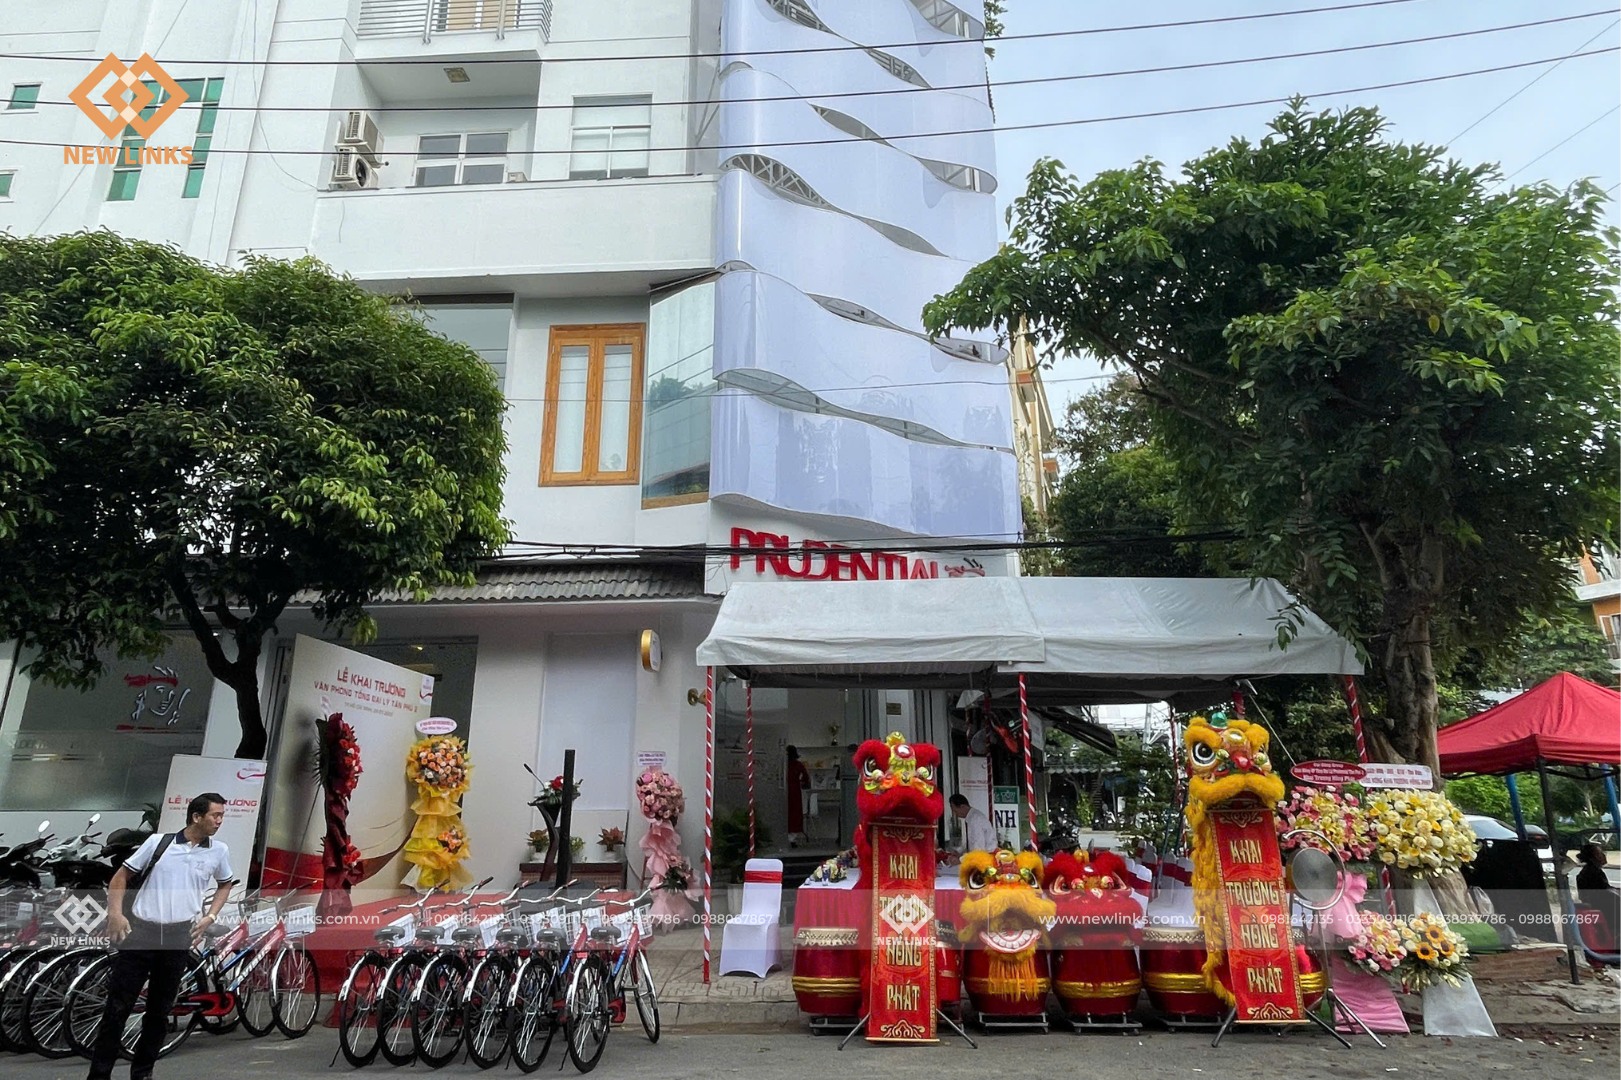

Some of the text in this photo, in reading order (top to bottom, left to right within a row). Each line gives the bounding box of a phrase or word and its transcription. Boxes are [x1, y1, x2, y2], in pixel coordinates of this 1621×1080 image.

[730, 527, 938, 581] PRUDENTIAL
[350, 673, 372, 689] KHAI
[224, 798, 257, 807] RƯƠNG
[1229, 839, 1263, 864] KHAI
[889, 854, 918, 880] KHAI
[1240, 913, 1279, 949] HỒNG
[1247, 962, 1283, 994] PHÁT
[886, 979, 920, 1011] PHÁT
